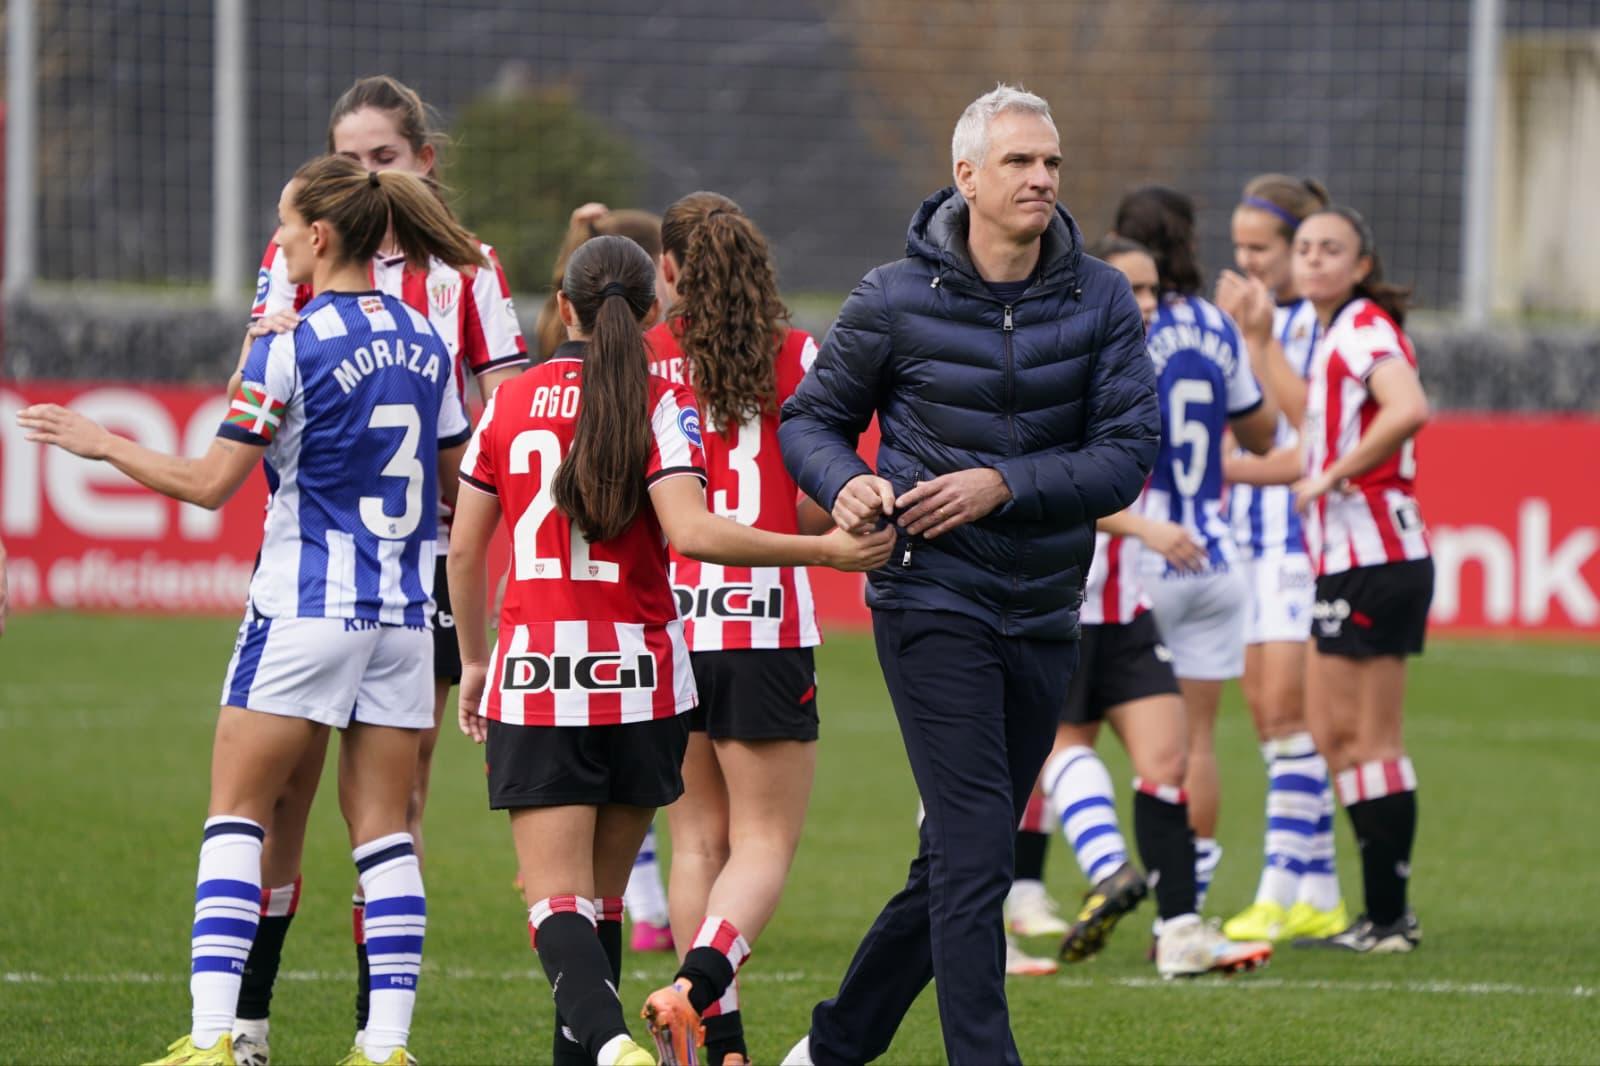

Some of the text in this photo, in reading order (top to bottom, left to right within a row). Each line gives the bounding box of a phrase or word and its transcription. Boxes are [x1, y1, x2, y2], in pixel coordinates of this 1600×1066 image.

[333, 339, 440, 394] MORAZA
[359, 404, 424, 539] 3
[706, 400, 761, 527] 3
[1168, 379, 1214, 497] 5
[1431, 497, 1600, 626] nk
[502, 653, 656, 691] DIGI
